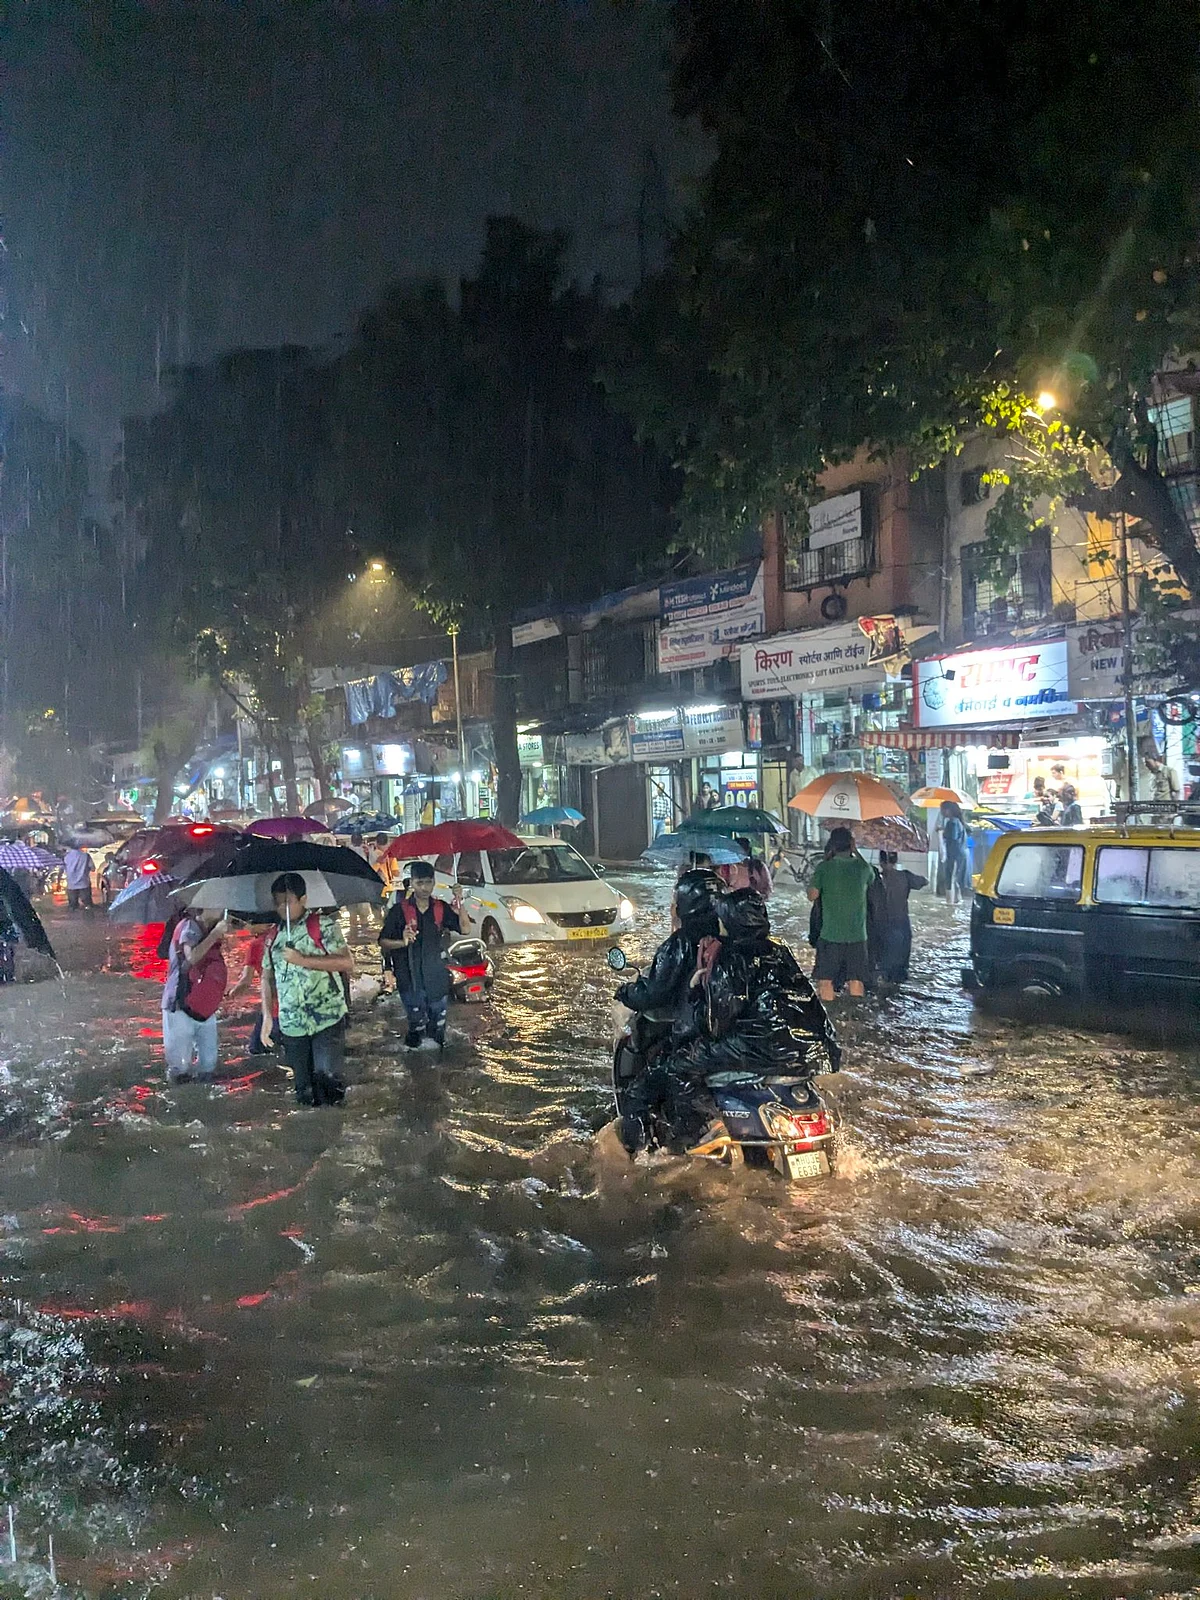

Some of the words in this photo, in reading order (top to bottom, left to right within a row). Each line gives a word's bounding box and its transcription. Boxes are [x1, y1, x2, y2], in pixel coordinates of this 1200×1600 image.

[754, 649, 793, 673] किरण
[823, 647, 843, 661] आणि
[844, 643, 866, 659] टॉईज
[1091, 657, 1118, 671] NEW
[747, 678, 766, 688] SPORTS
[815, 668, 828, 677] GIFT
[690, 712, 713, 725] PERFECT
[713, 707, 739, 722] ACADEMY
[522, 741, 540, 751] STORES
